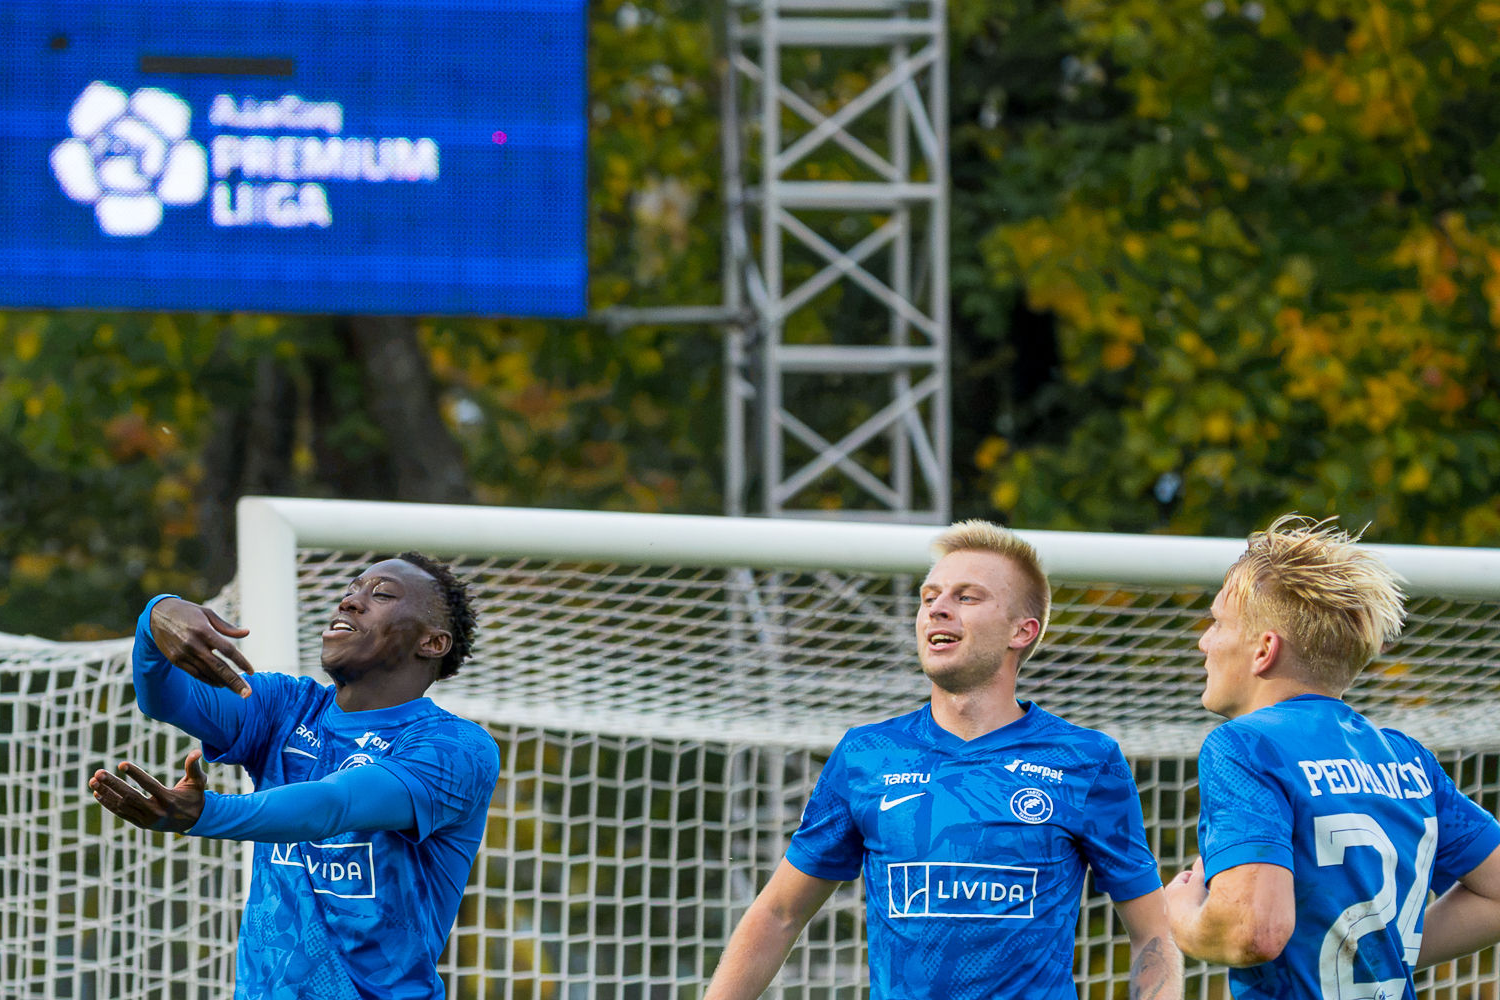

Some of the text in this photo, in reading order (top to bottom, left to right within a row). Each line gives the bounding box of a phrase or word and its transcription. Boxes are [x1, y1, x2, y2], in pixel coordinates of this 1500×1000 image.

[211, 135, 440, 181] PREMIUM
[211, 181, 333, 227] LIGA
[305, 854, 362, 882] VIDA
[937, 880, 1024, 903] LIVIDA
